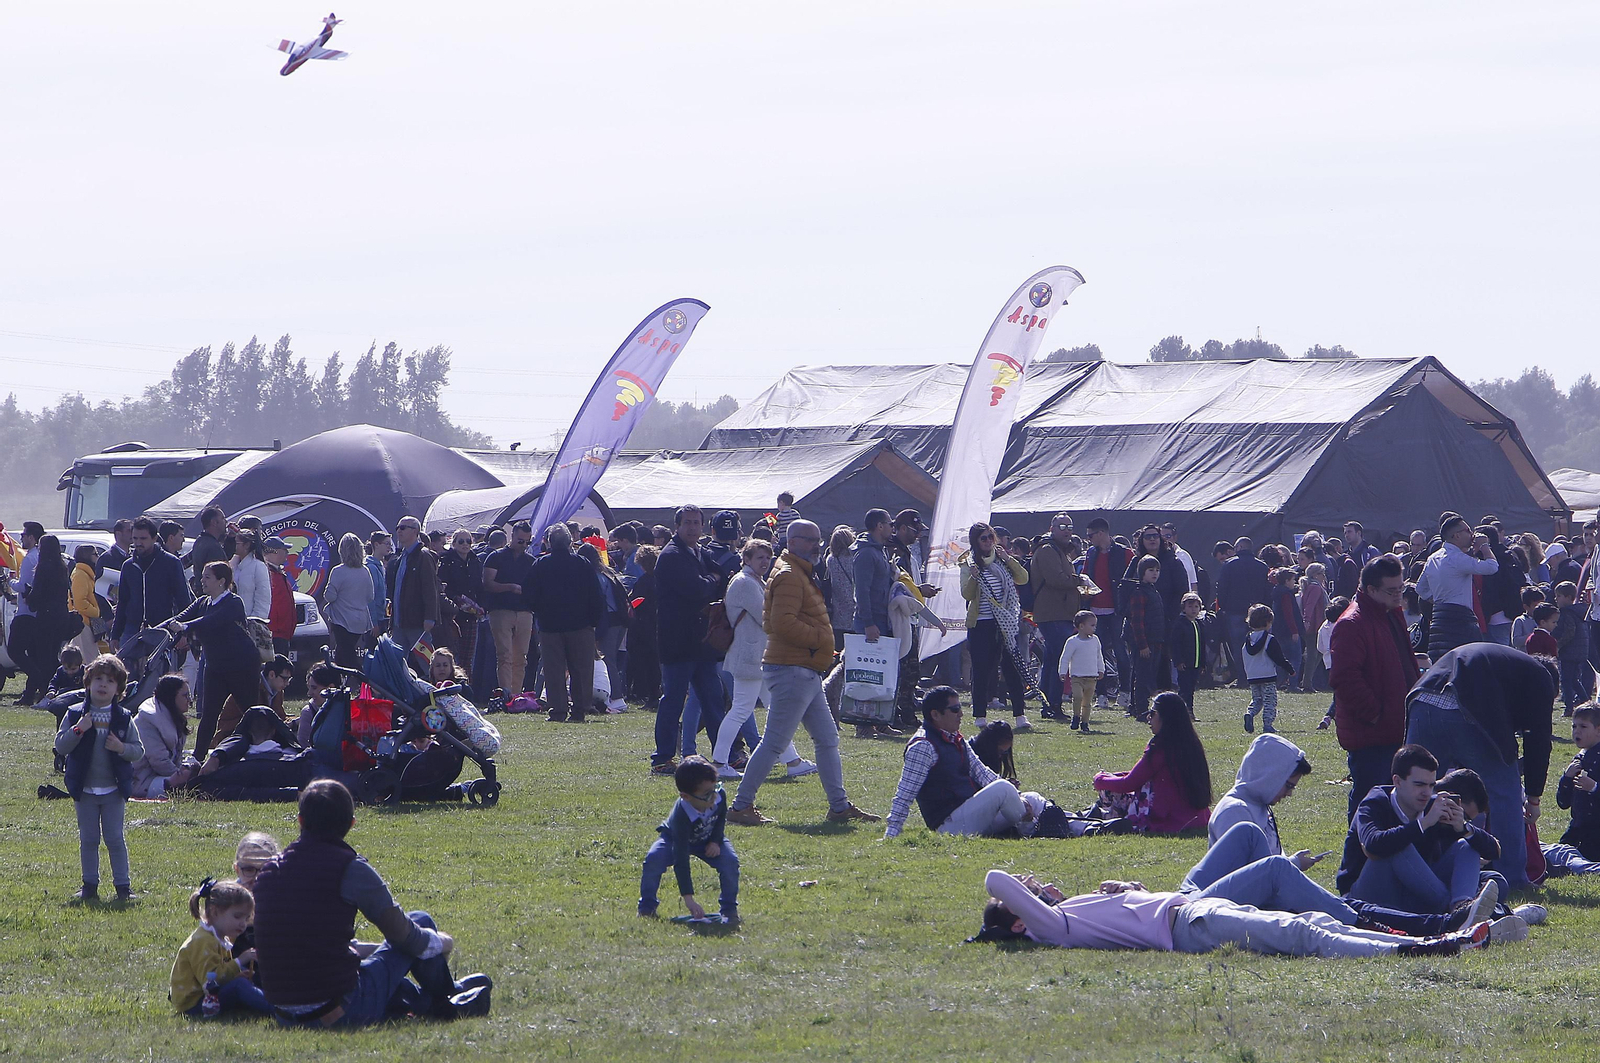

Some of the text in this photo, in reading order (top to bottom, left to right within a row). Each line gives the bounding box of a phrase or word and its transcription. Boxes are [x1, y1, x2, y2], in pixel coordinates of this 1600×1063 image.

[1007, 305, 1047, 332] Aspa
[304, 520, 319, 531] DEL
[321, 530, 337, 547] AIRE
